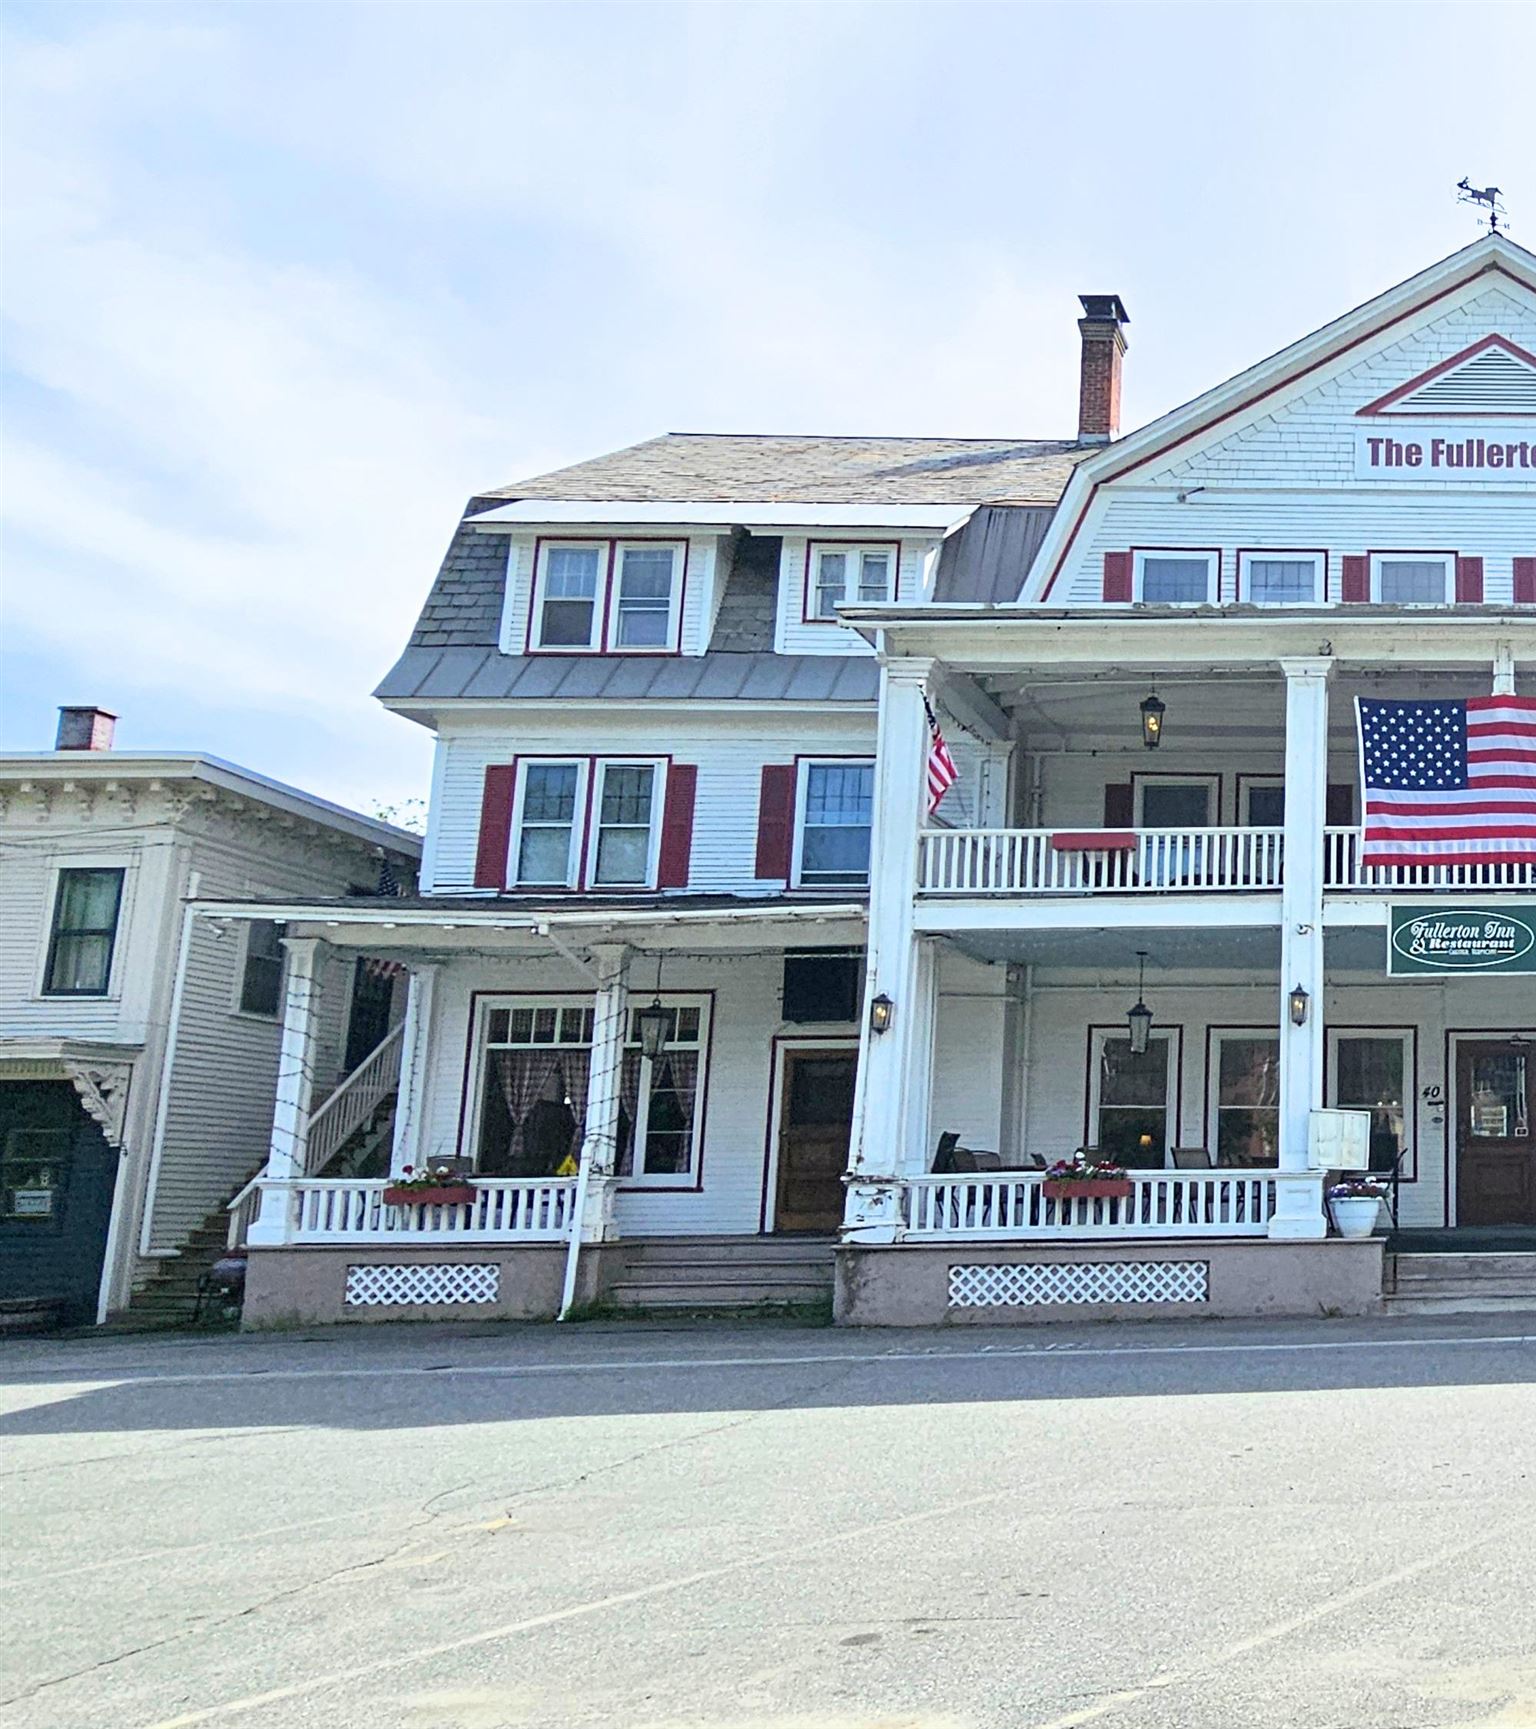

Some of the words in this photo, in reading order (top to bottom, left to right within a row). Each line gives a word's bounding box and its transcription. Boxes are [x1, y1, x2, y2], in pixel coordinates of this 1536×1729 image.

[1366, 438, 1423, 467] The
[1410, 921, 1480, 938] Fullerton
[1484, 921, 1516, 938] Inn
[1409, 937, 1429, 954] &
[1429, 938, 1515, 949] Restaurant
[1422, 1086, 1441, 1098] 40
